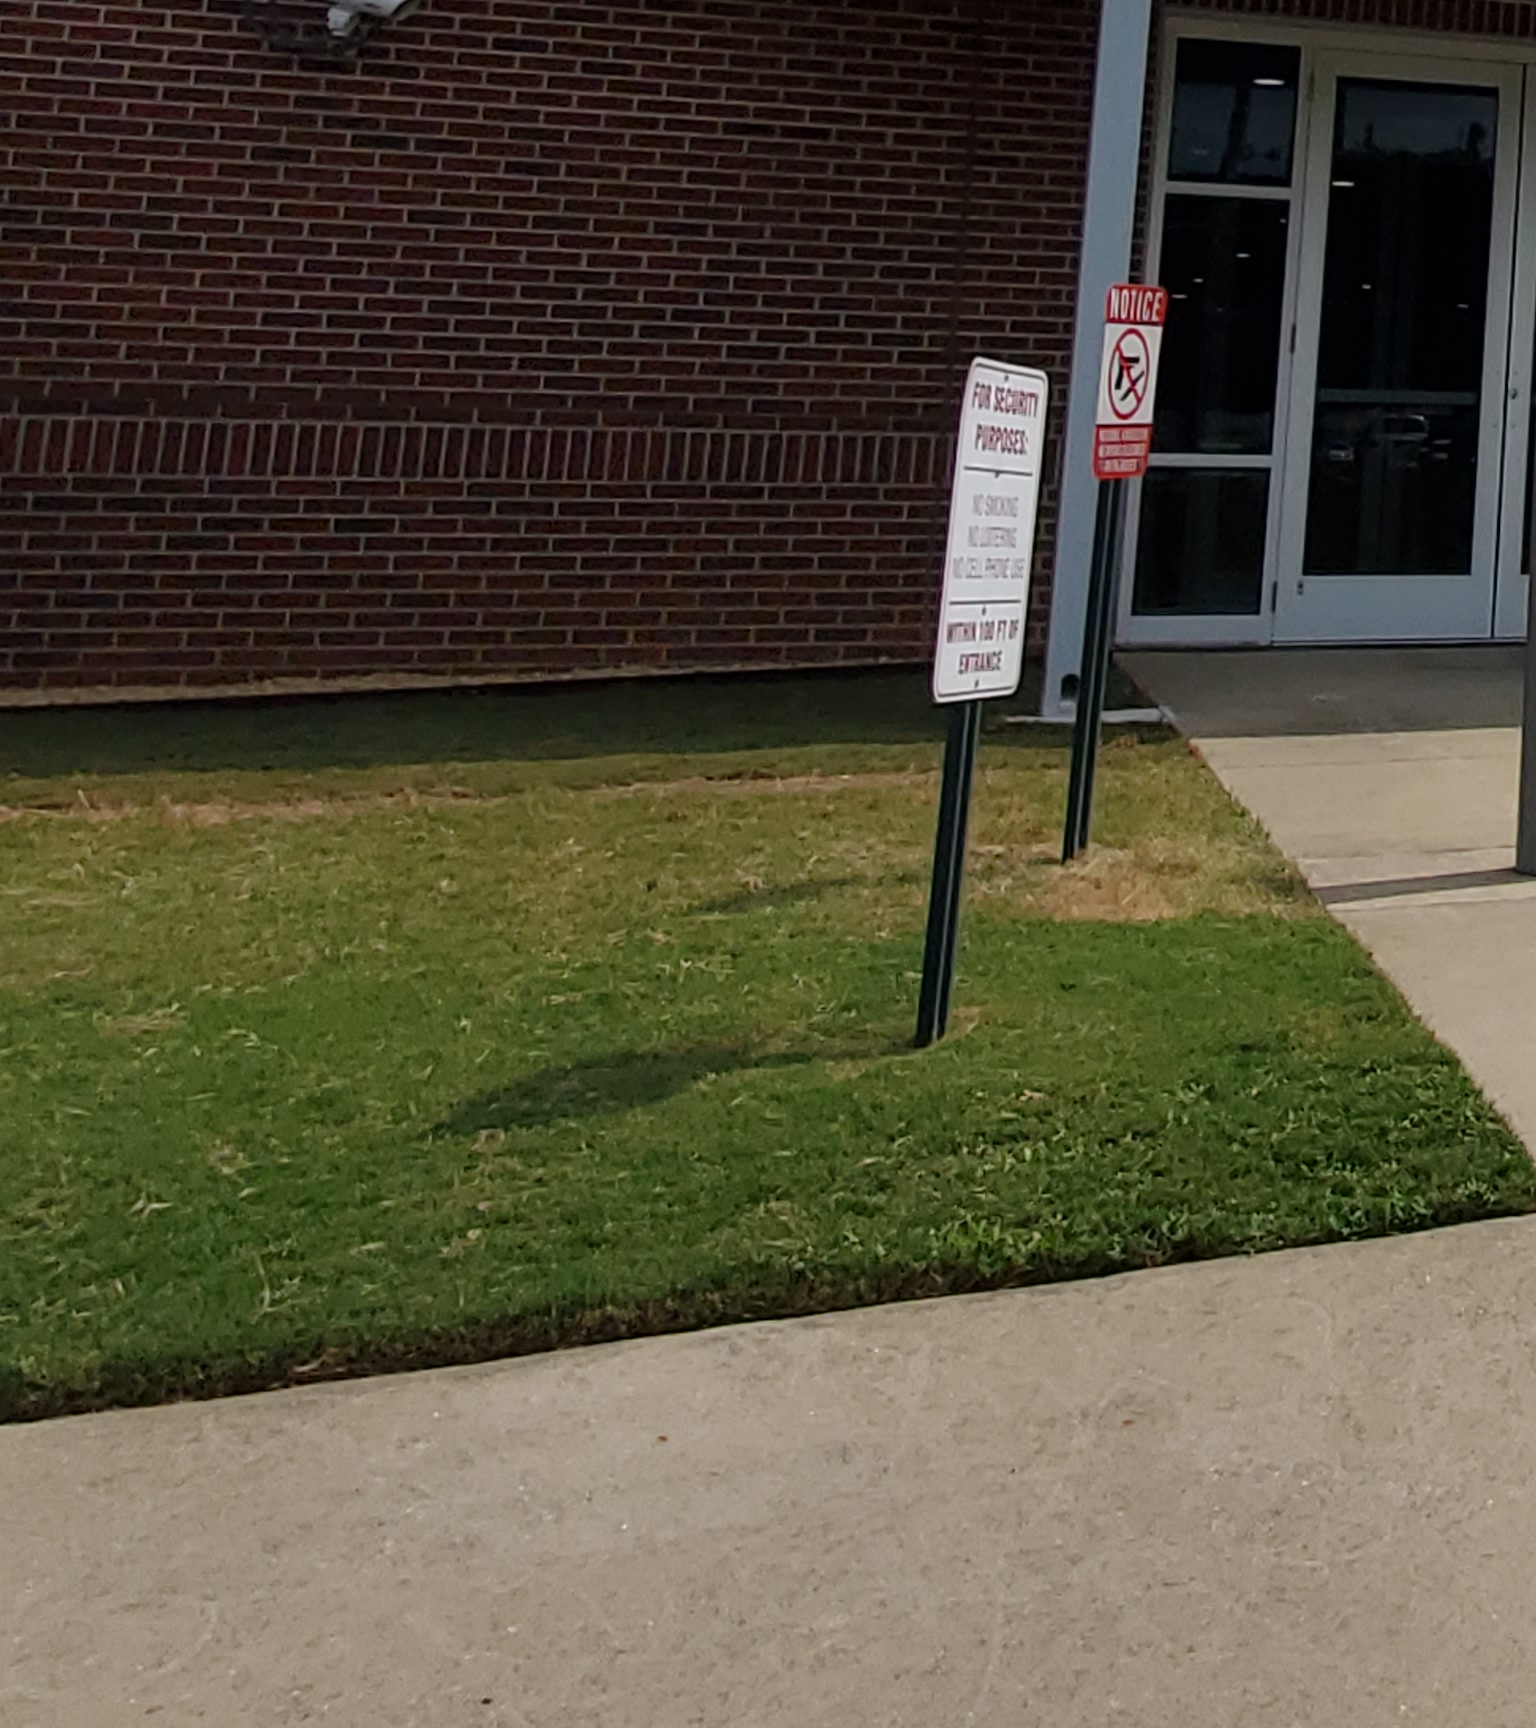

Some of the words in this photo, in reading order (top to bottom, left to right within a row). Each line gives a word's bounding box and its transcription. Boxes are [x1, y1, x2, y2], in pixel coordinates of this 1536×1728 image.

[1109, 287, 1164, 321] NOTICE
[972, 381, 992, 410] FOR
[994, 385, 1039, 418] SECURITY
[974, 423, 1029, 455] PURPOSES:
[972, 494, 984, 516] NO
[985, 494, 1019, 518] SMOKING
[968, 525, 979, 548] NO
[953, 557, 964, 579] NO
[966, 557, 984, 579] CELL
[985, 557, 1010, 579] PHONE
[946, 622, 977, 643] WITHIN
[979, 620, 995, 642] 100
[997, 619, 1008, 641] FT
[1008, 618, 1019, 640] OF
[958, 650, 1003, 675] ENTRANCE
